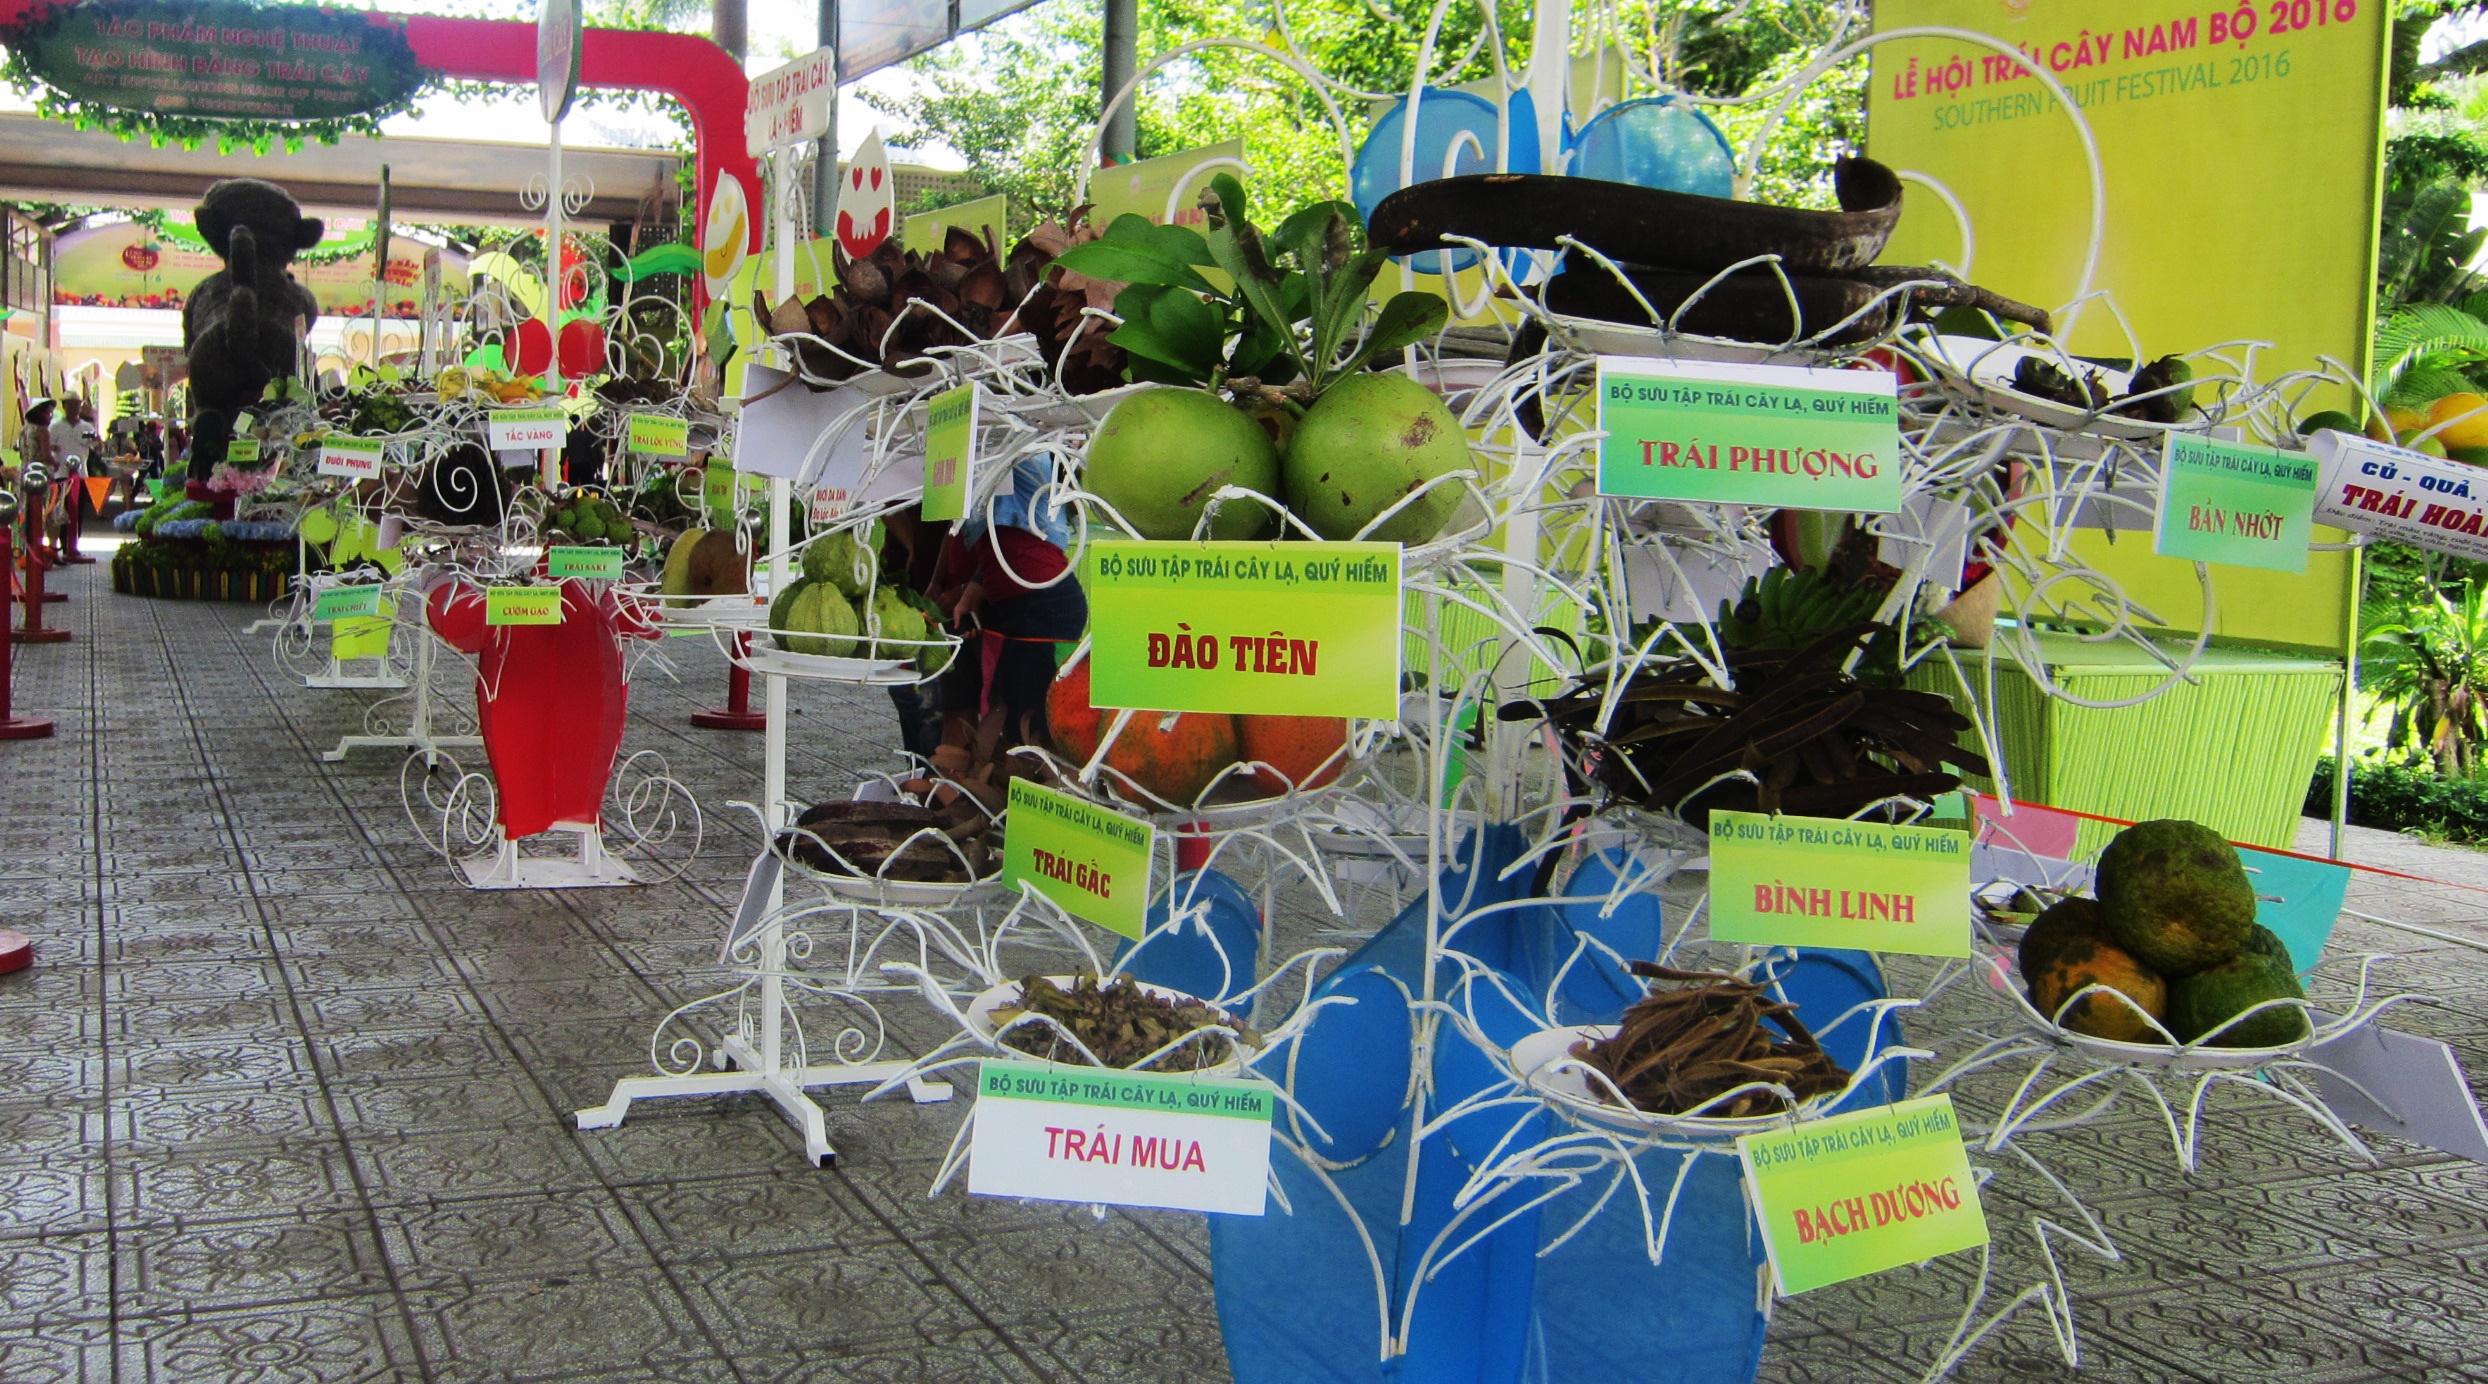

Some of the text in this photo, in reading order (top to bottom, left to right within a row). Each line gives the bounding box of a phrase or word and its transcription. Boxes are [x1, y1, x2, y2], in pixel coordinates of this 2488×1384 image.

[1894, 57, 1916, 100] LỄ
[1925, 54, 1973, 95] HỘI
[2050, 30, 2113, 73] CÂY
[2124, 17, 2198, 59] NAM
[2209, 0, 2257, 51] BỘ
[2268, 0, 2356, 35] 2016
[1934, 92, 2041, 131] SOUTHERN
[2117, 62, 2222, 105] FESTIVAL
[2229, 49, 2291, 84] 2016
[1611, 383, 1889, 415] BỘ SƯU TẬP TRÁI CÂY LẠ, QUÝ HIẾM
[1638, 438, 1878, 481] TRÁI PHƯỢNG
[2175, 449, 2313, 481] BỘ SƯU TẬP TRÁI CÂY LẠ, QUÝ HIẾM
[2361, 462, 2398, 479] CỦ
[2419, 476, 2476, 500] QUẢ,
[2188, 498, 2284, 541] BẢN NHỚT
[2342, 484, 2418, 519] TRÁI
[1101, 553, 1388, 585] BỘ SƯU TẬP TRÁI CÂY LẠ, QUÝ HIẾM
[1148, 622, 1318, 676] ĐÀO TIÊN
[1011, 788, 1145, 846] BỘ SƯU TẬP TRÁI CÂY LẠ, QUÝ HIẾM
[1714, 820, 1959, 854] BỘ SƯU TẬP TRÁI CÂY LẠ, QUÝ HIẾM
[1033, 848, 1111, 898] TRÁI GẤC
[1754, 879, 1915, 923] BÌNH LINH
[989, 1073, 1262, 1113] BỘ SƯU TẬP TRÁI CÂY LẠ, QUÝ HIẾM
[1044, 1124, 1206, 1173] TRÁI MUA
[1753, 1107, 1951, 1171] BỘ SƯU TẬP TRÁI CÂY LẠ, QUÝ HIẾM
[1793, 1176, 1961, 1247] BẠCH DƯƠNG
